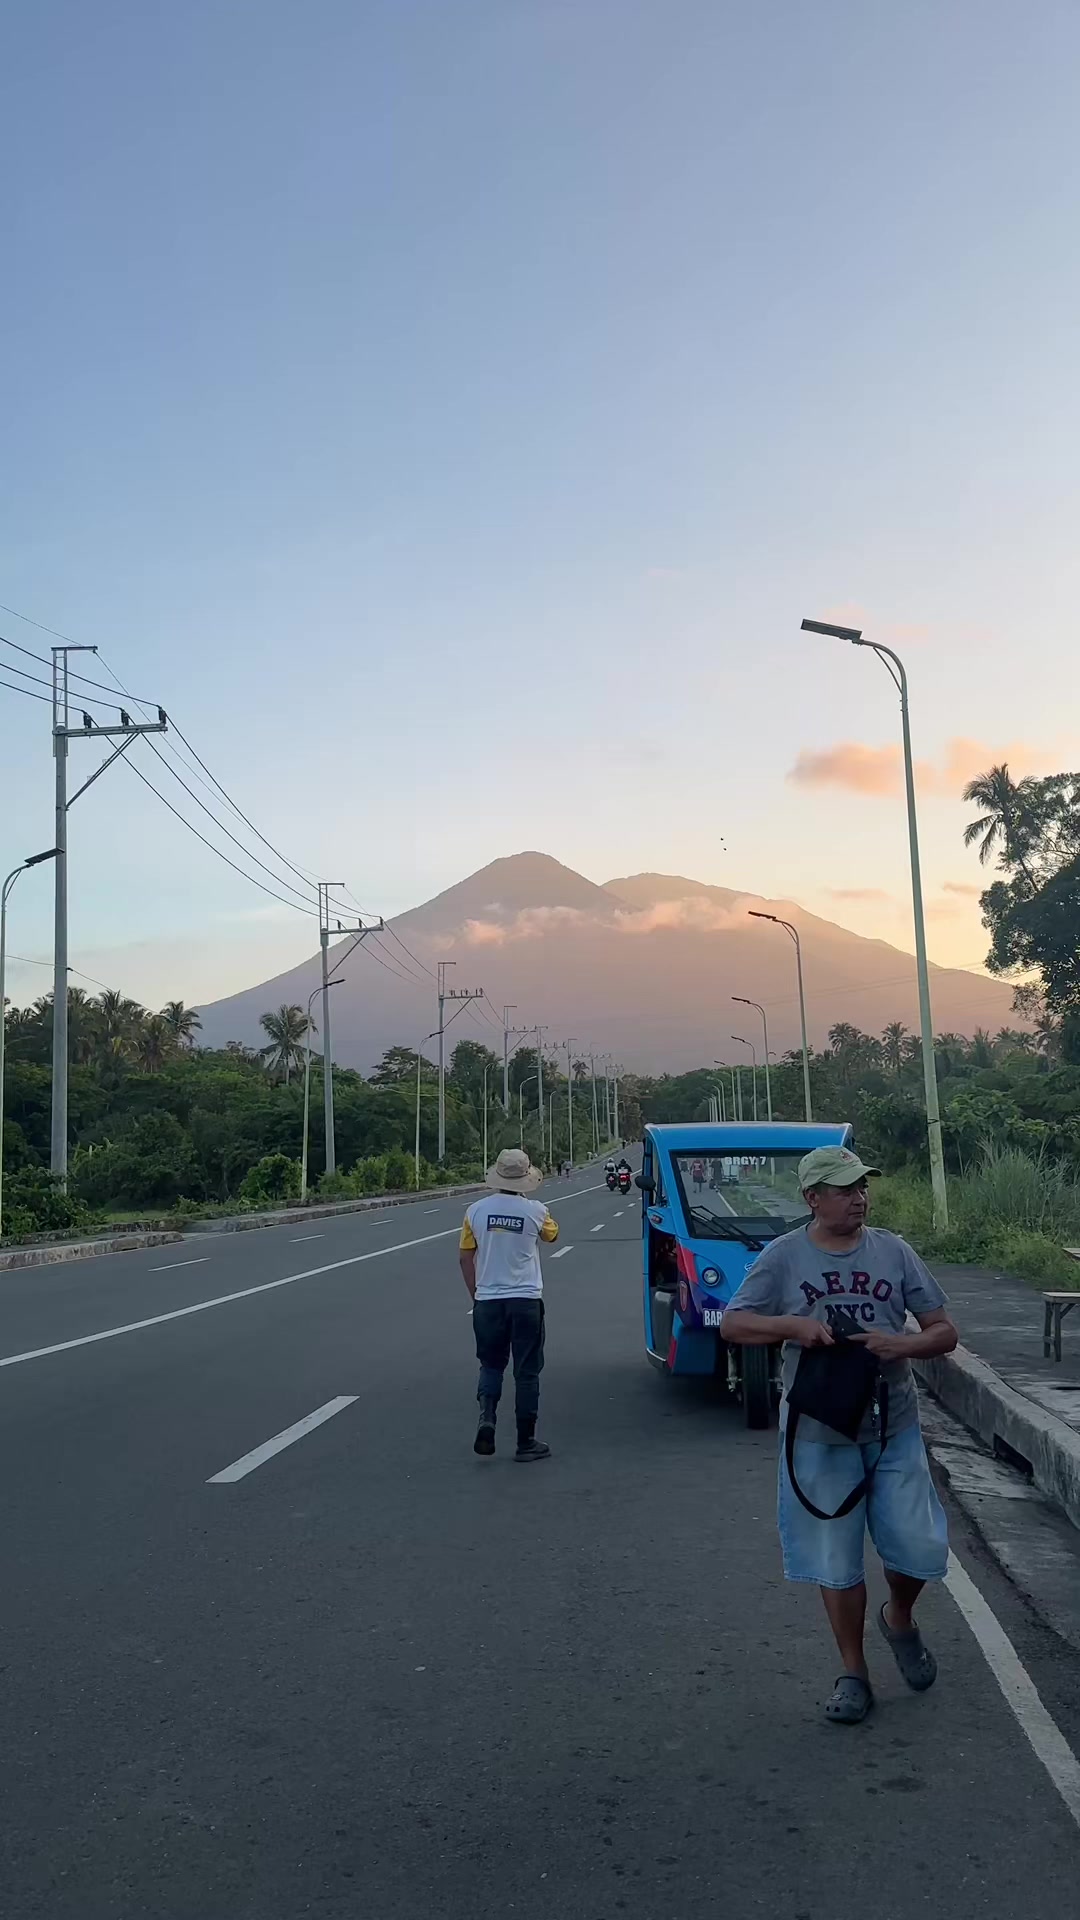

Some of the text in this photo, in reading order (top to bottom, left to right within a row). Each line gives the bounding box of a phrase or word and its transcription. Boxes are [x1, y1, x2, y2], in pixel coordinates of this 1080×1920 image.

[760, 1156, 766, 1165] 7
[489, 1217, 522, 1228] DAVIES
[800, 1271, 892, 1306] AERO
[825, 1302, 875, 1323] NYC
